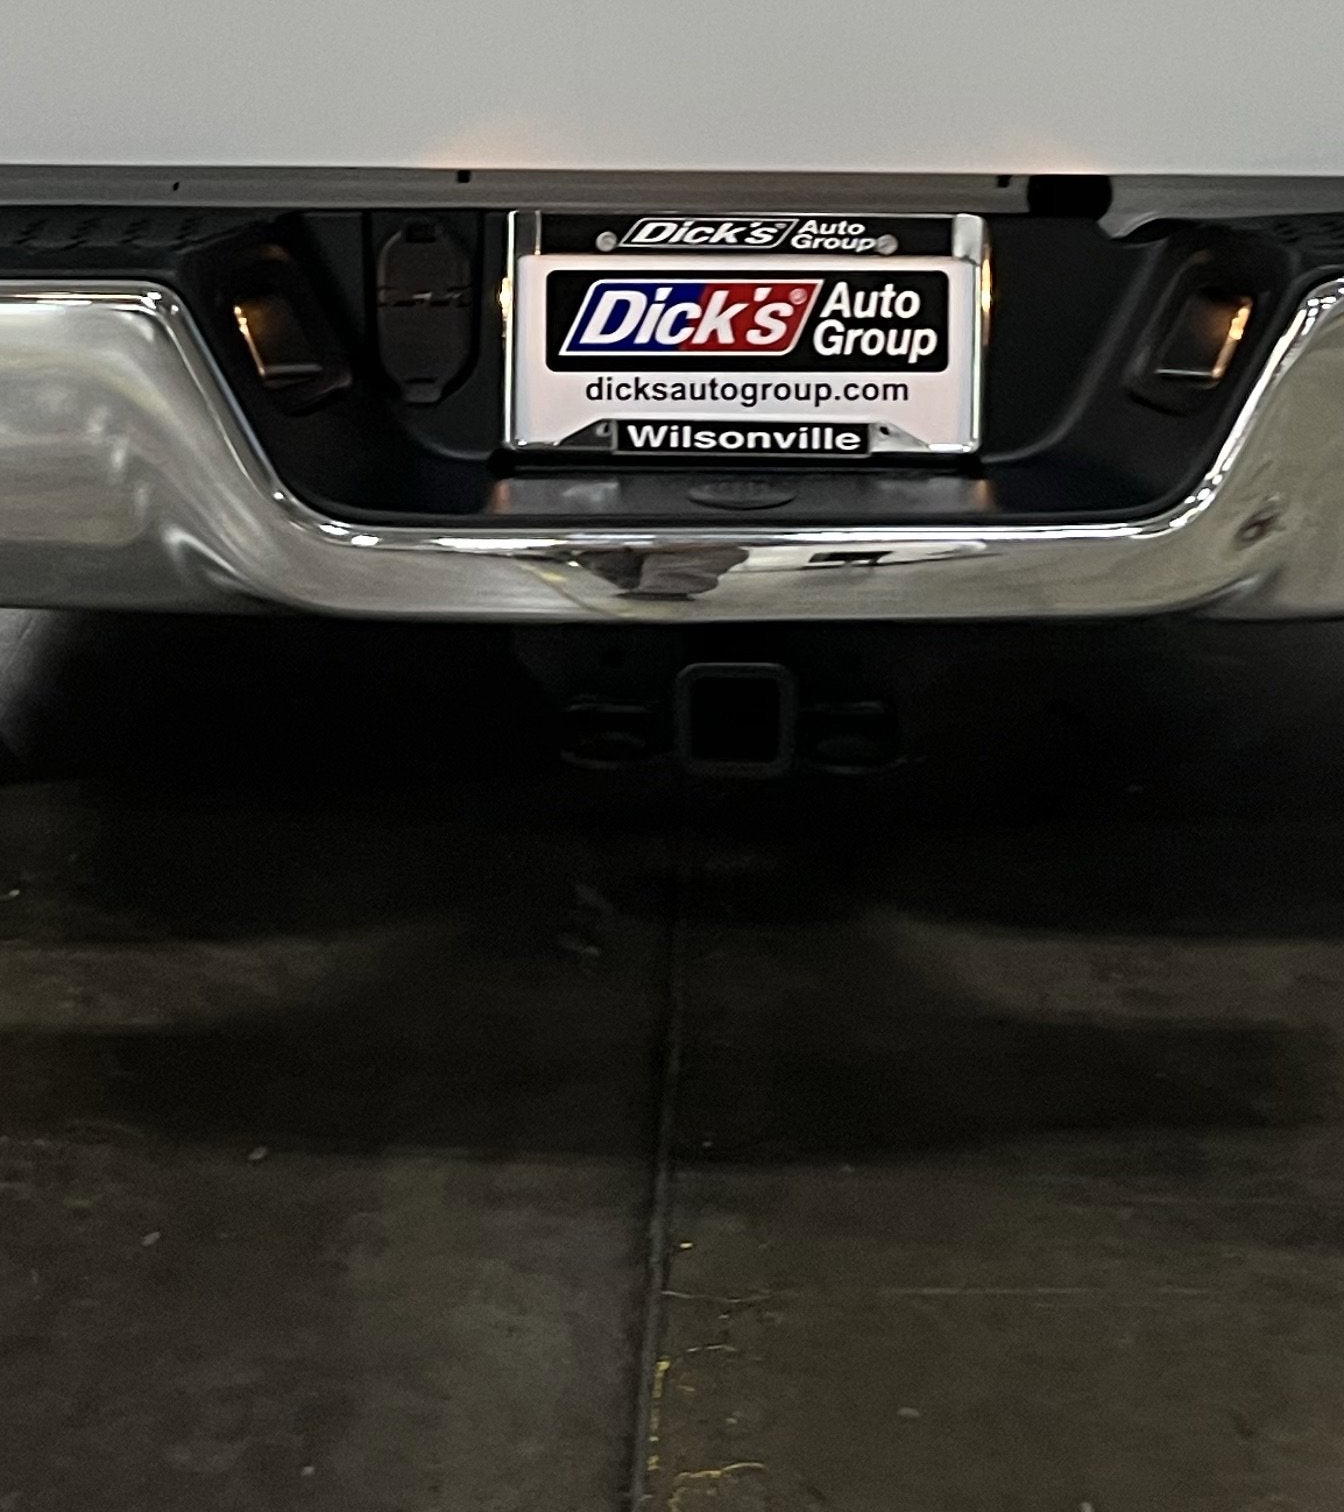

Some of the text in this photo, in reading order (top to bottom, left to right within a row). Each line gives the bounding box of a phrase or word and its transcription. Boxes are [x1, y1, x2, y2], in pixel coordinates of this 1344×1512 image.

[635, 219, 866, 246] Dick's Auto
[790, 234, 877, 253] Group
[579, 281, 921, 345] Dick's Auto
[813, 318, 939, 364] Group
[584, 376, 910, 408] dicksautogroup.com
[627, 423, 862, 451] Wilsonville
